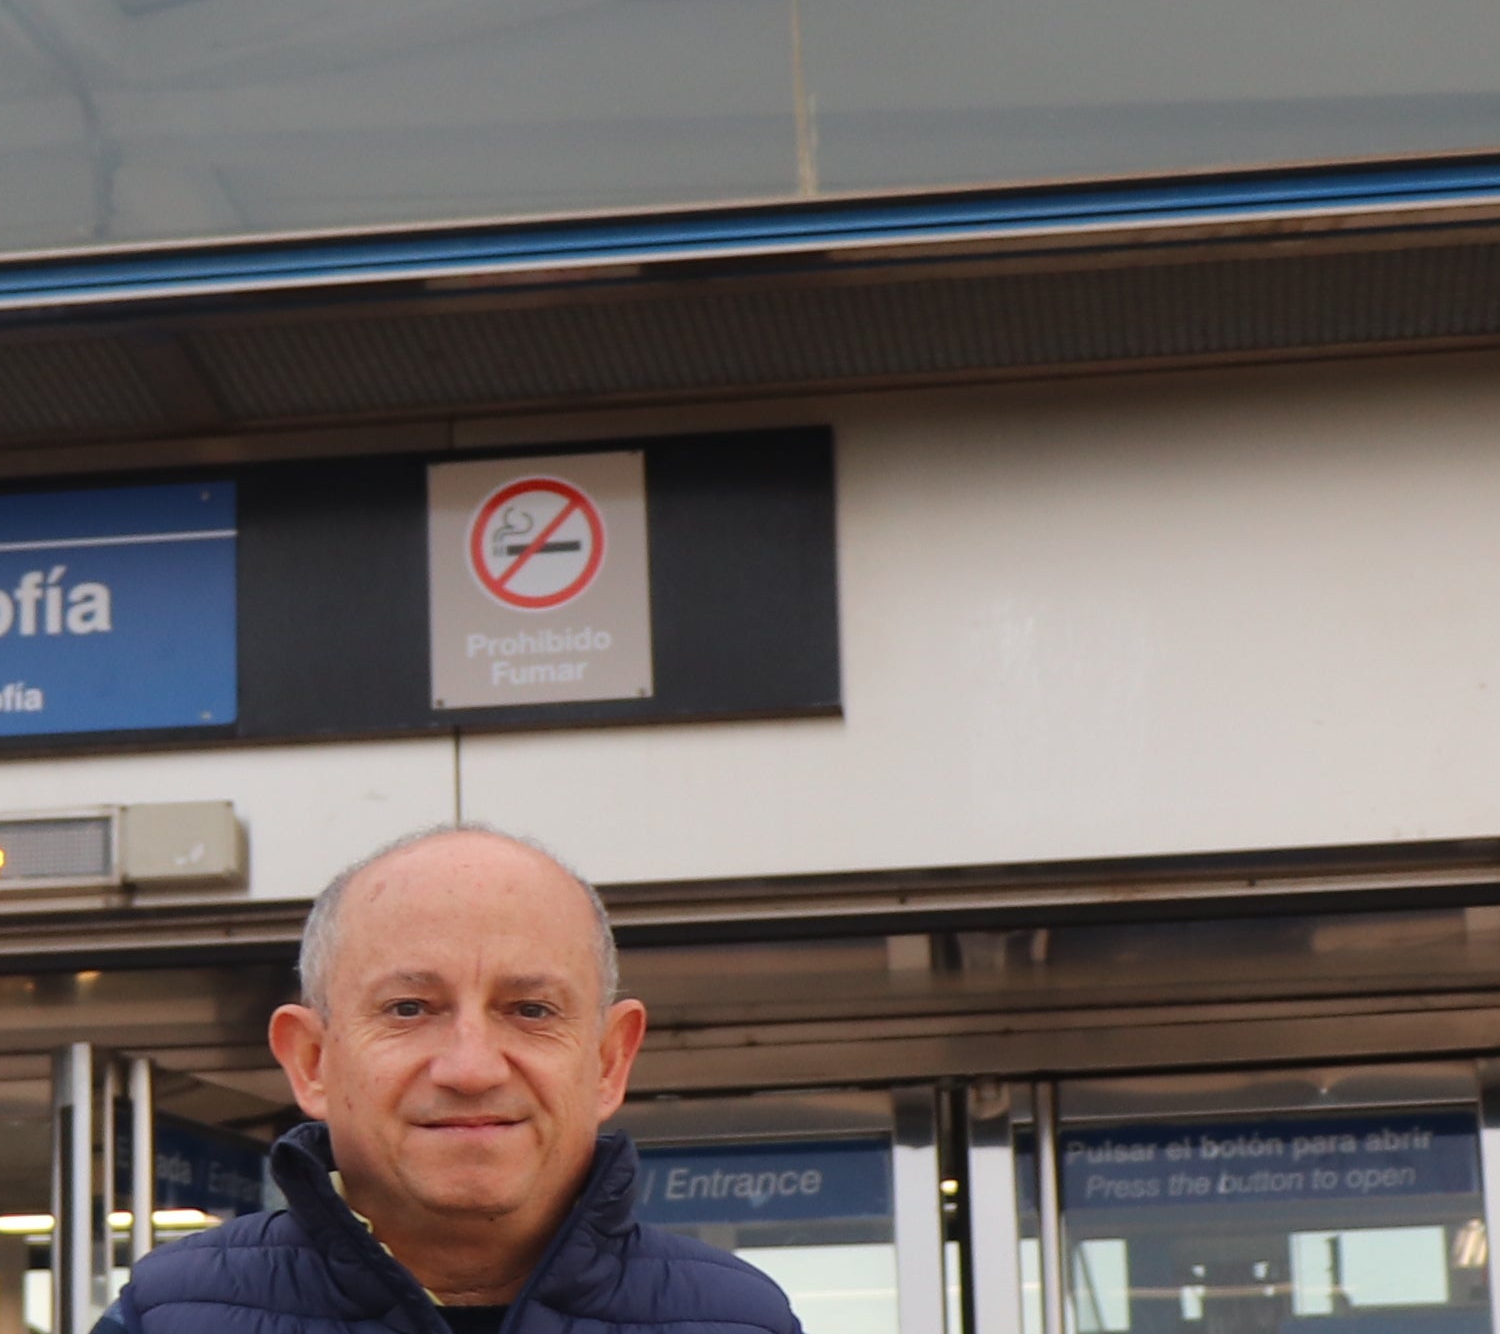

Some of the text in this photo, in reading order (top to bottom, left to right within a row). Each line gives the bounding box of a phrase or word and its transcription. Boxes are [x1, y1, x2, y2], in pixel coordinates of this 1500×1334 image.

[467, 626, 613, 658] Prohibido
[491, 661, 589, 687] Fumar
[1066, 1125, 1434, 1166] Pulsar el botón para abrir
[665, 1167, 823, 1201] Entrance
[1086, 1163, 1416, 1198] Press the button to open
